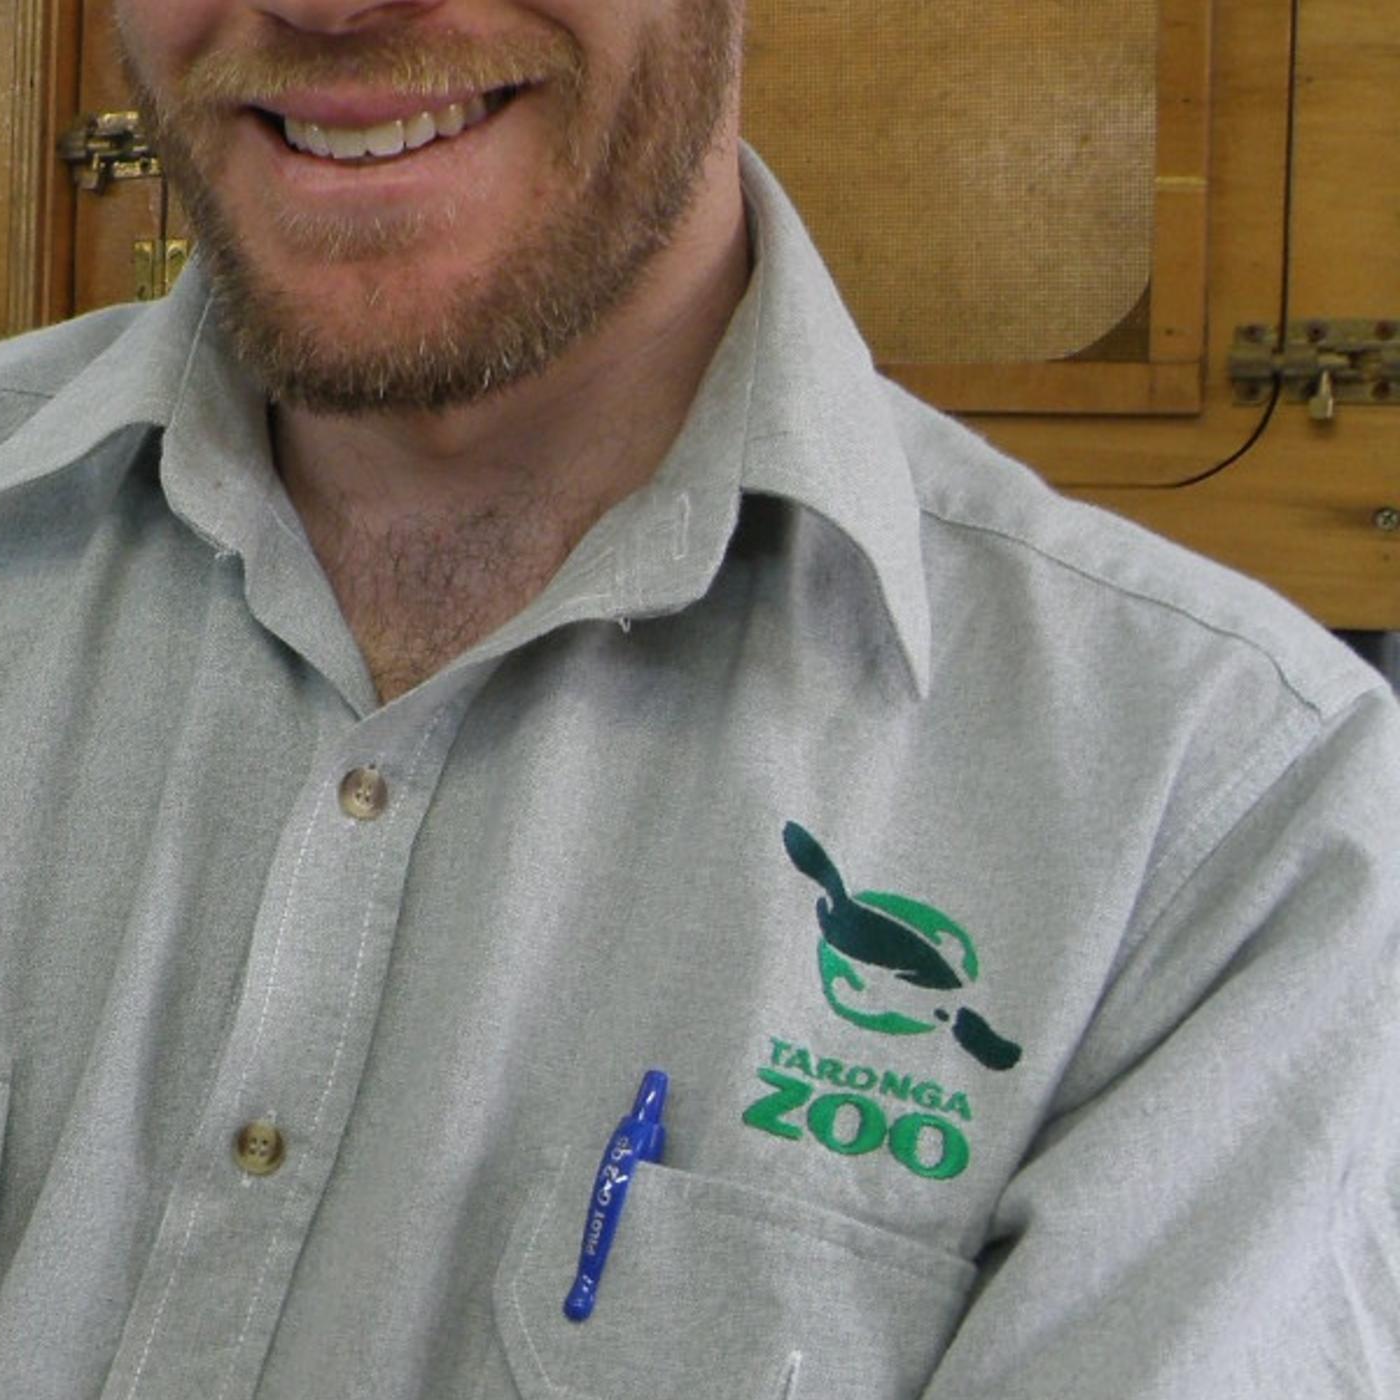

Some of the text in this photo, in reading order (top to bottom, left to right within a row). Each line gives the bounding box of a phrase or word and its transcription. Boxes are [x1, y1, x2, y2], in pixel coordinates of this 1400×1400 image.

[769, 1036, 973, 1121] TARONGA
[741, 1066, 971, 1180] ZOO
[585, 1209, 606, 1256] PILOT
